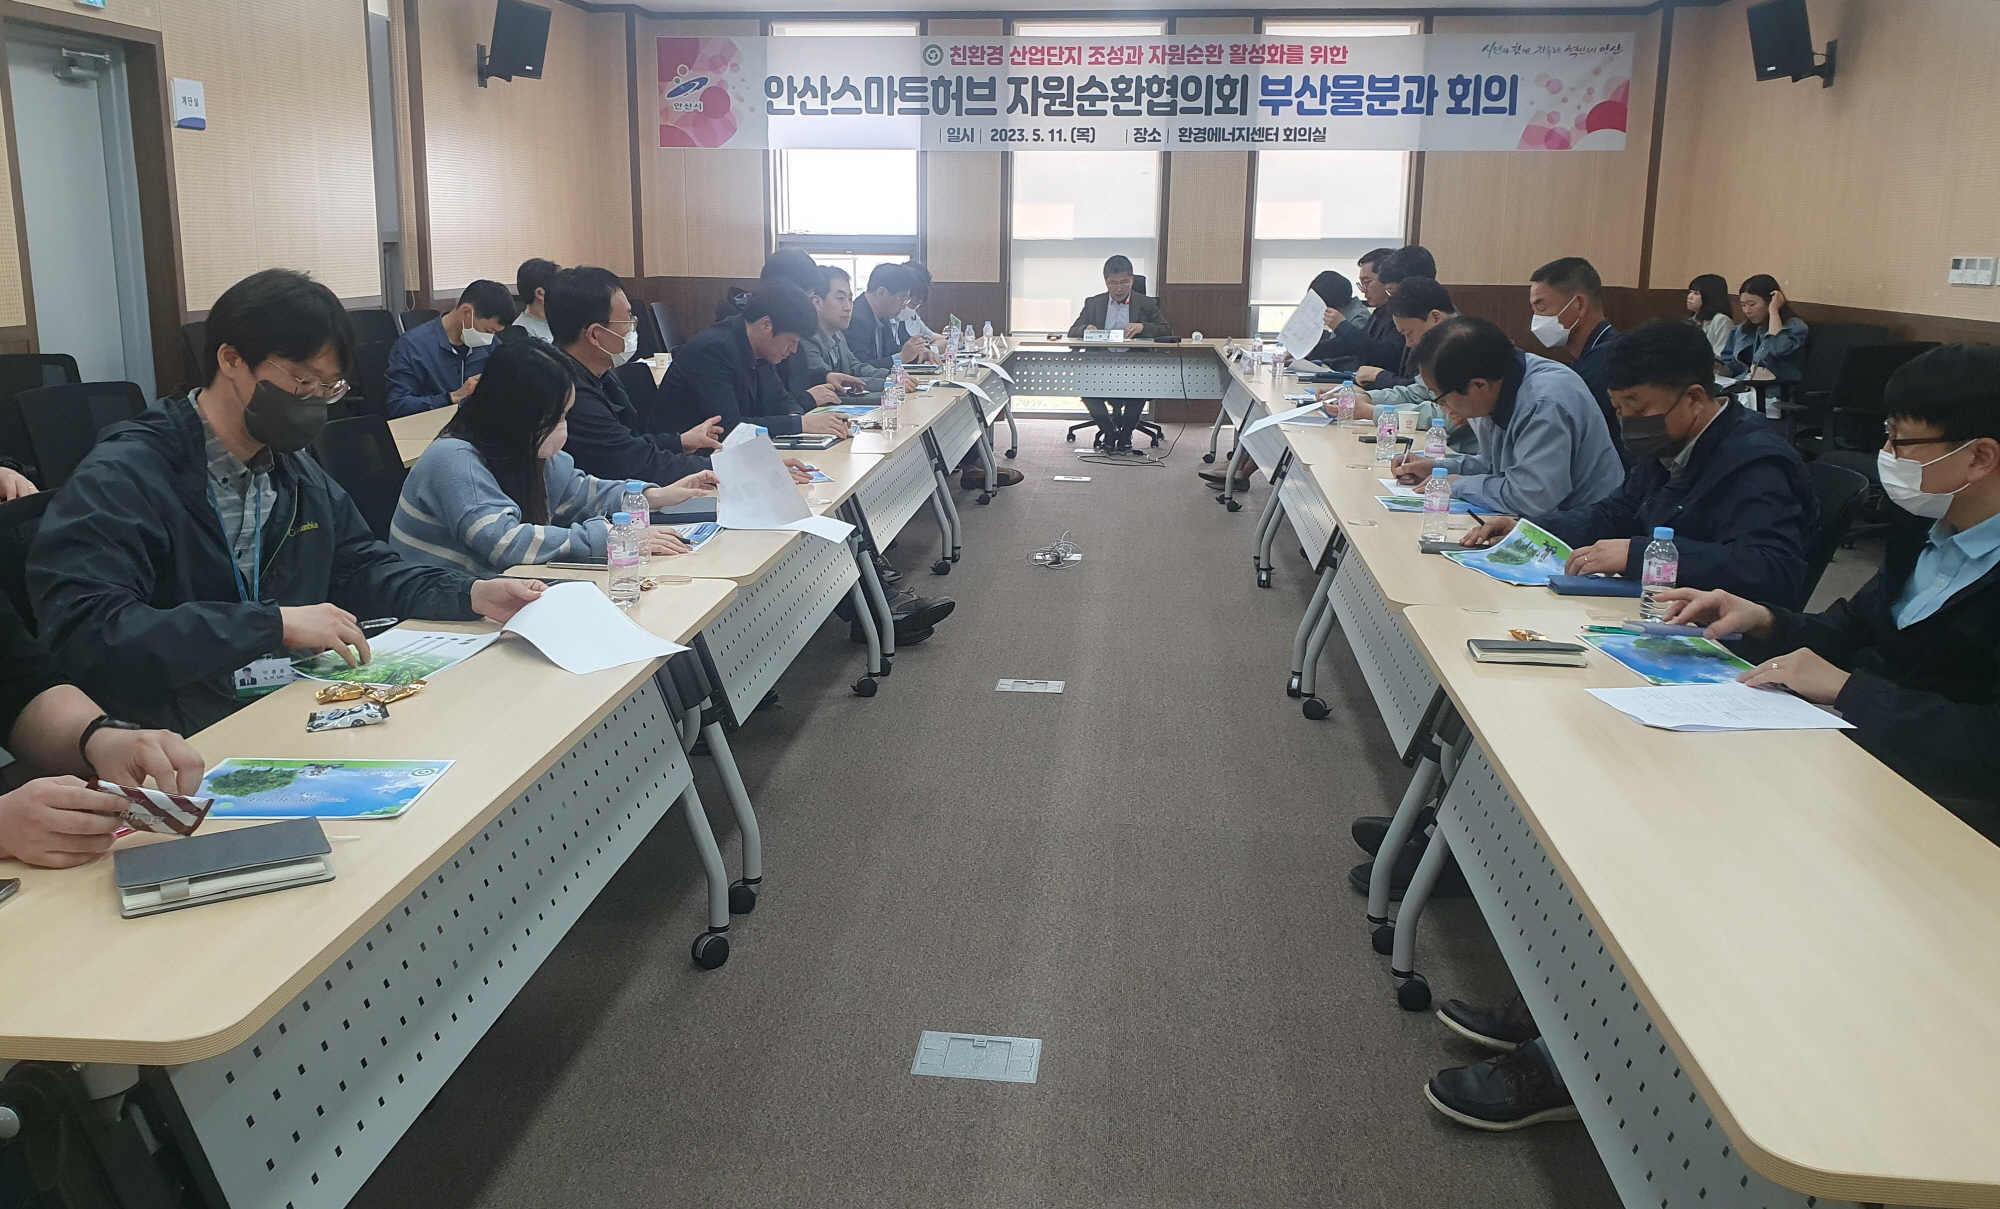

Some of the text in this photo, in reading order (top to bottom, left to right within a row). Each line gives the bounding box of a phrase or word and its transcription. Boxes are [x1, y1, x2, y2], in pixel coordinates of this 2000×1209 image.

[949, 44, 1348, 66] 친환경 산업단지 조성과 자원순환 활성화를 위한
[181, 95, 199, 108] 계단실
[764, 74, 1518, 117] 안산스마트허브 자원순환협의회 부산물분과 회의
[673, 102, 703, 111] 안산시
[946, 127, 975, 143] 일시
[990, 128, 1028, 142] 2023.
[1032, 128, 1044, 142] 5.
[1133, 127, 1327, 143] 장소 환경에너지센터 회의실
